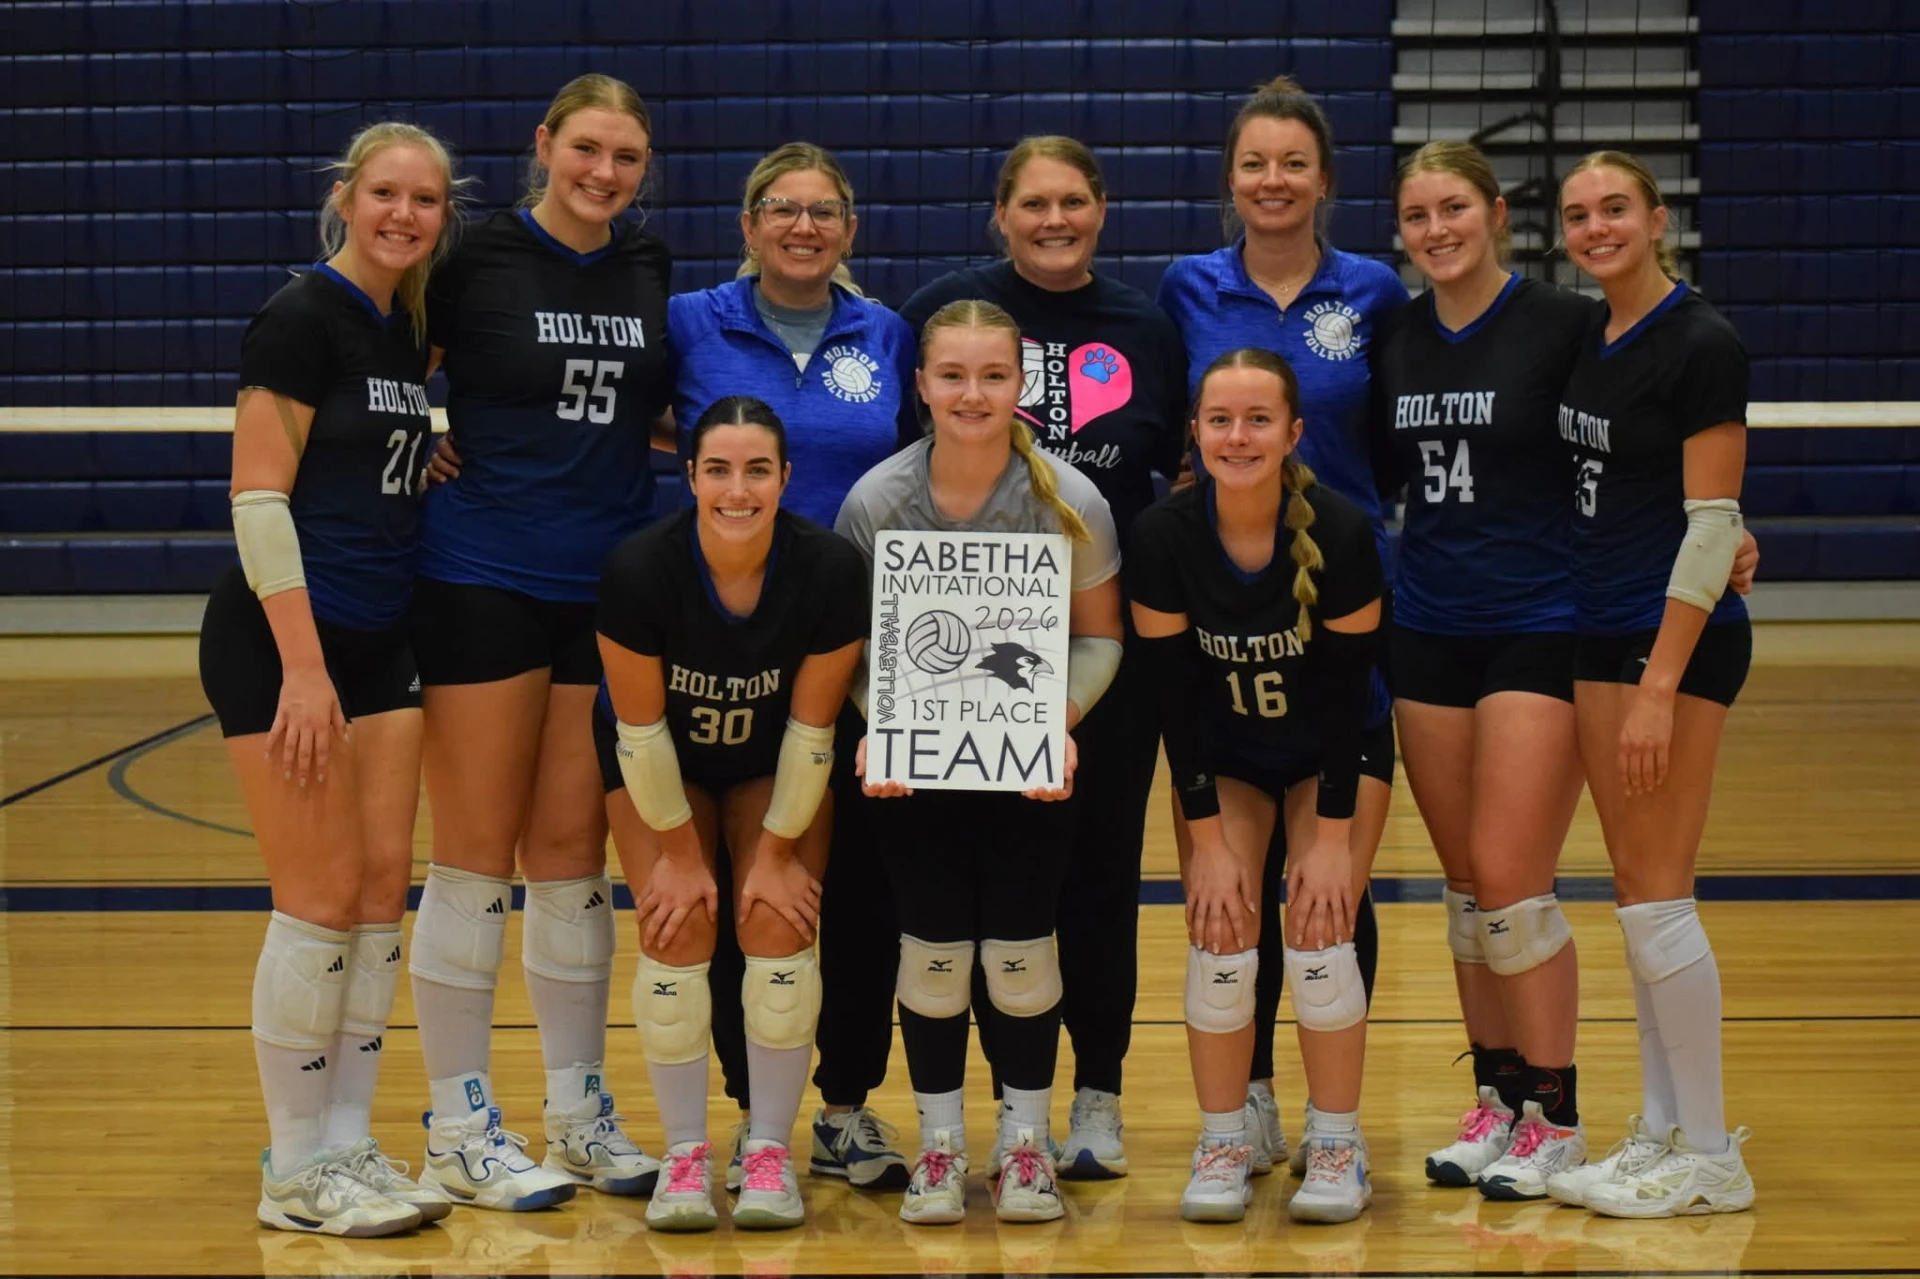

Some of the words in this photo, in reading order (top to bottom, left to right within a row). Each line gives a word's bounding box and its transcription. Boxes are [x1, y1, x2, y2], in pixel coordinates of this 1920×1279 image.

[534, 312, 645, 349] HOLTON
[823, 345, 880, 373] HOLTON
[556, 359, 625, 425] 55
[821, 370, 882, 403] VOLLEYBALL
[1046, 342, 1069, 440] HOLTON
[1395, 391, 1496, 429] HOLTON
[1558, 403, 1612, 453] OLTON
[381, 429, 423, 496] 21
[1418, 439, 1475, 503] 54
[884, 539, 1059, 574] SABETHA
[882, 574, 1059, 598] INVITATIONAL
[975, 605, 1059, 632] 2026
[877, 593, 901, 724] VOLLEYBALL
[1196, 626, 1305, 663] HOLTON
[669, 664, 781, 702] HOLTON
[1226, 670, 1288, 718] 16
[689, 706, 754, 746] 30
[911, 699, 949, 721] 1ST
[960, 700, 1048, 724] PLACE
[875, 728, 1054, 783] TEAM
